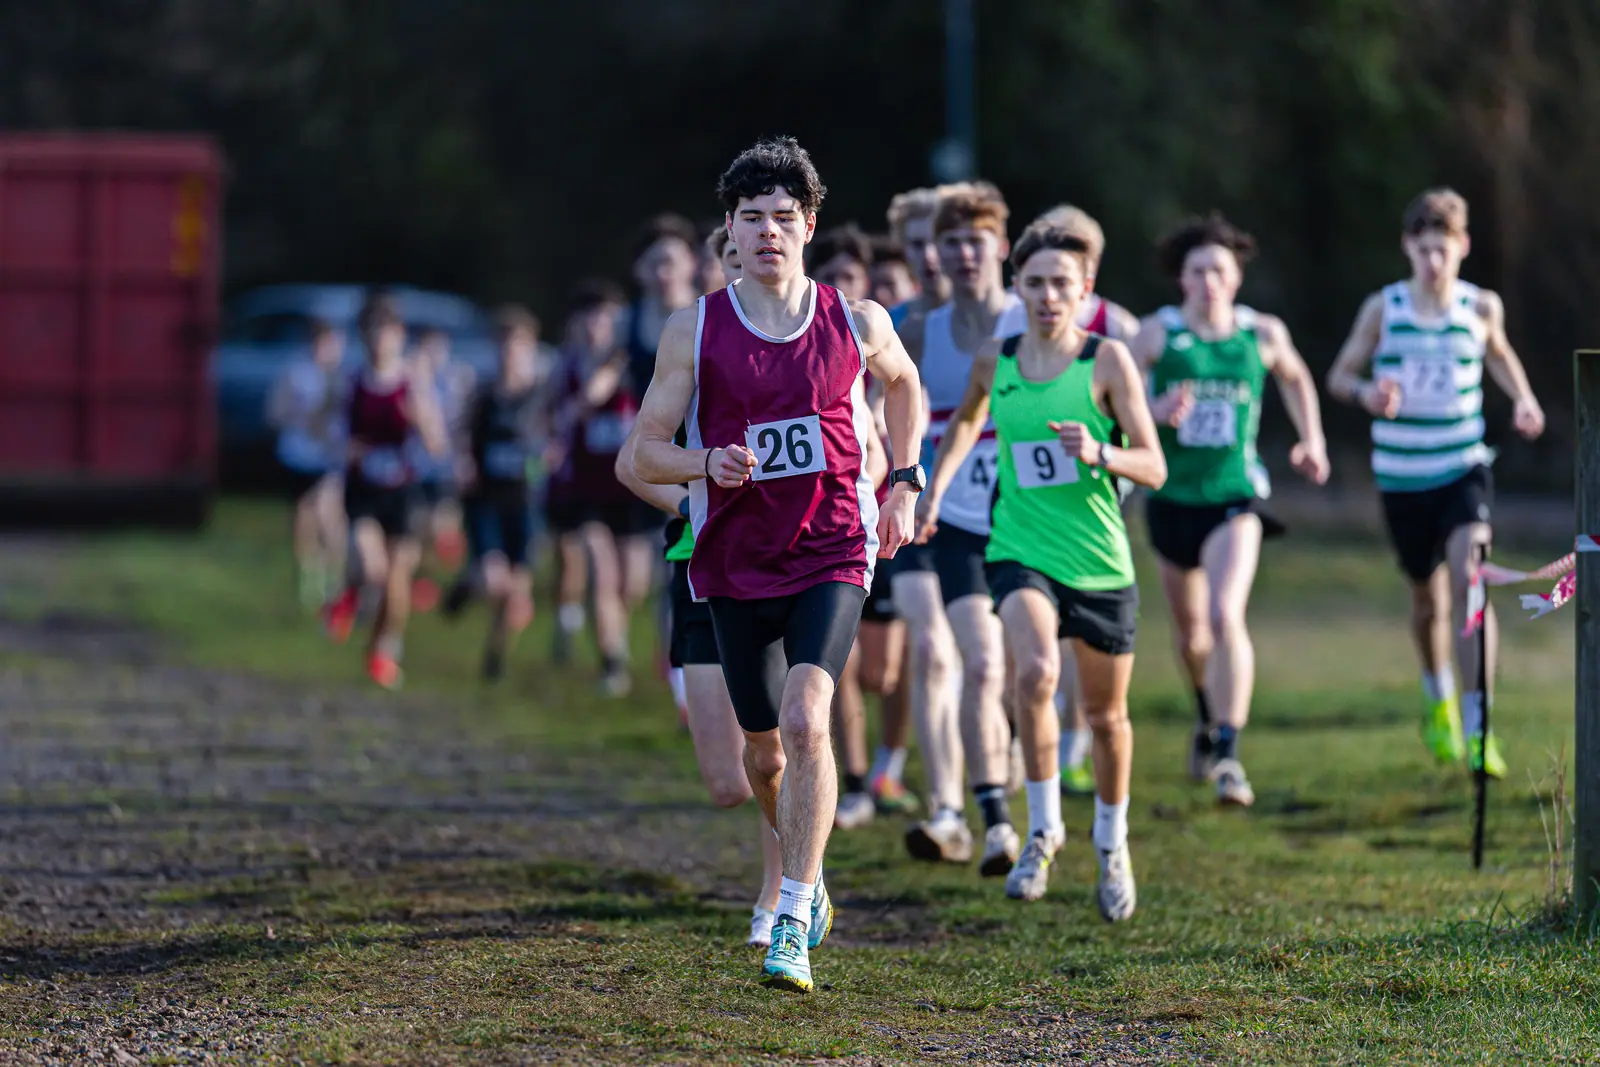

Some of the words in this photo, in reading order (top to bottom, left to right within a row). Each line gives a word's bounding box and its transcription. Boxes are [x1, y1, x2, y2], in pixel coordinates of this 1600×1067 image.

[757, 423, 813, 474] 26
[1032, 445, 1056, 482] 9
[970, 455, 998, 490] 4
